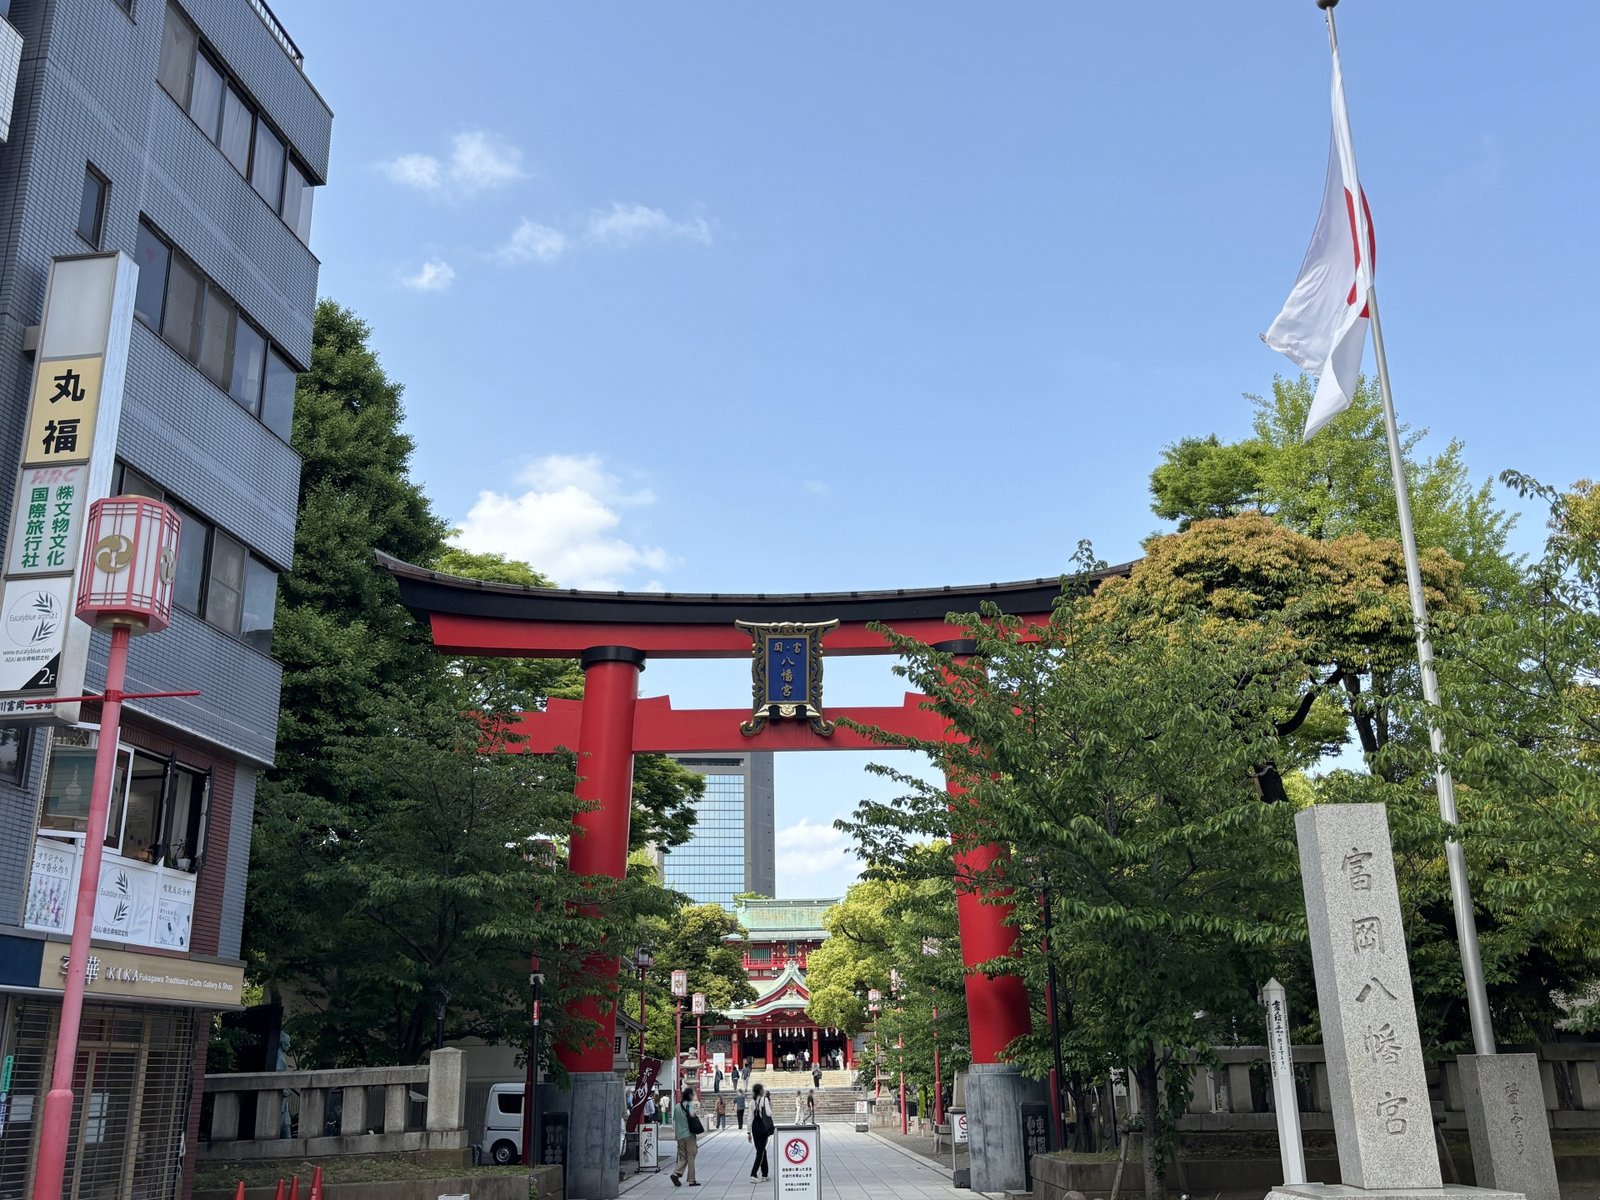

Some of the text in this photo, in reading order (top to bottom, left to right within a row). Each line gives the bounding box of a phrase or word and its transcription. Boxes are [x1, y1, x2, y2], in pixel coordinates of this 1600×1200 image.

[42, 368, 86, 455] 丸福
[21, 486, 49, 569] 国際旅行社
[38, 667, 56, 685] 2F
[107, 966, 139, 982] KIKA
[139, 972, 164, 984] Fukagawa
[222, 982, 234, 991] Shop
[1340, 846, 1409, 1138] 富岡八幡宮
